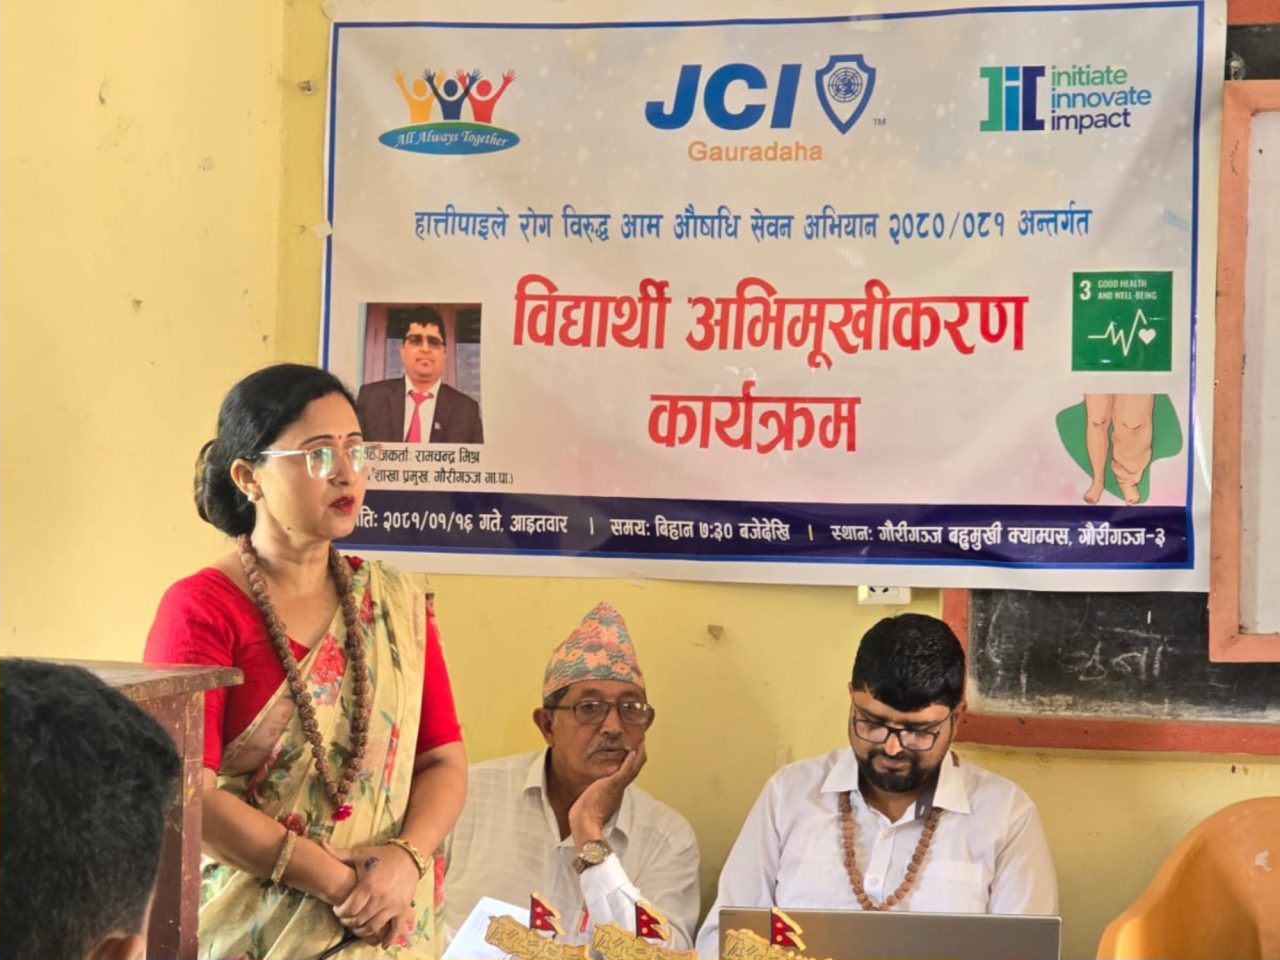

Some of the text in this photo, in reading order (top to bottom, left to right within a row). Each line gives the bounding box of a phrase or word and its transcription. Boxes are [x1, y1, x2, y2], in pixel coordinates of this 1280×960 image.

[1051, 65, 1128, 86] initiate
[645, 62, 803, 130] JCI
[1051, 87, 1152, 109] innovate
[1051, 108, 1131, 134] impact
[394, 130, 508, 147] All Always Together
[688, 140, 822, 162] Gauradaha
[415, 204, 509, 241] हात्तीपाइले
[519, 207, 553, 242] रोग
[621, 213, 664, 239] आम
[674, 203, 741, 239] औषधि
[750, 208, 794, 242] सेवन
[803, 205, 879, 240] अभियान
[888, 211, 1005, 244] २०८०/०८१
[1018, 201, 1092, 237] अन्तर्गत
[1080, 280, 1091, 300] 3
[1098, 279, 1147, 288] GOOD HEALTH
[1097, 291, 1114, 300] AND
[513, 274, 672, 349] विद्यार्थी
[647, 380, 862, 454] कार्यक्रम
[510, 513, 569, 534] आइतवार
